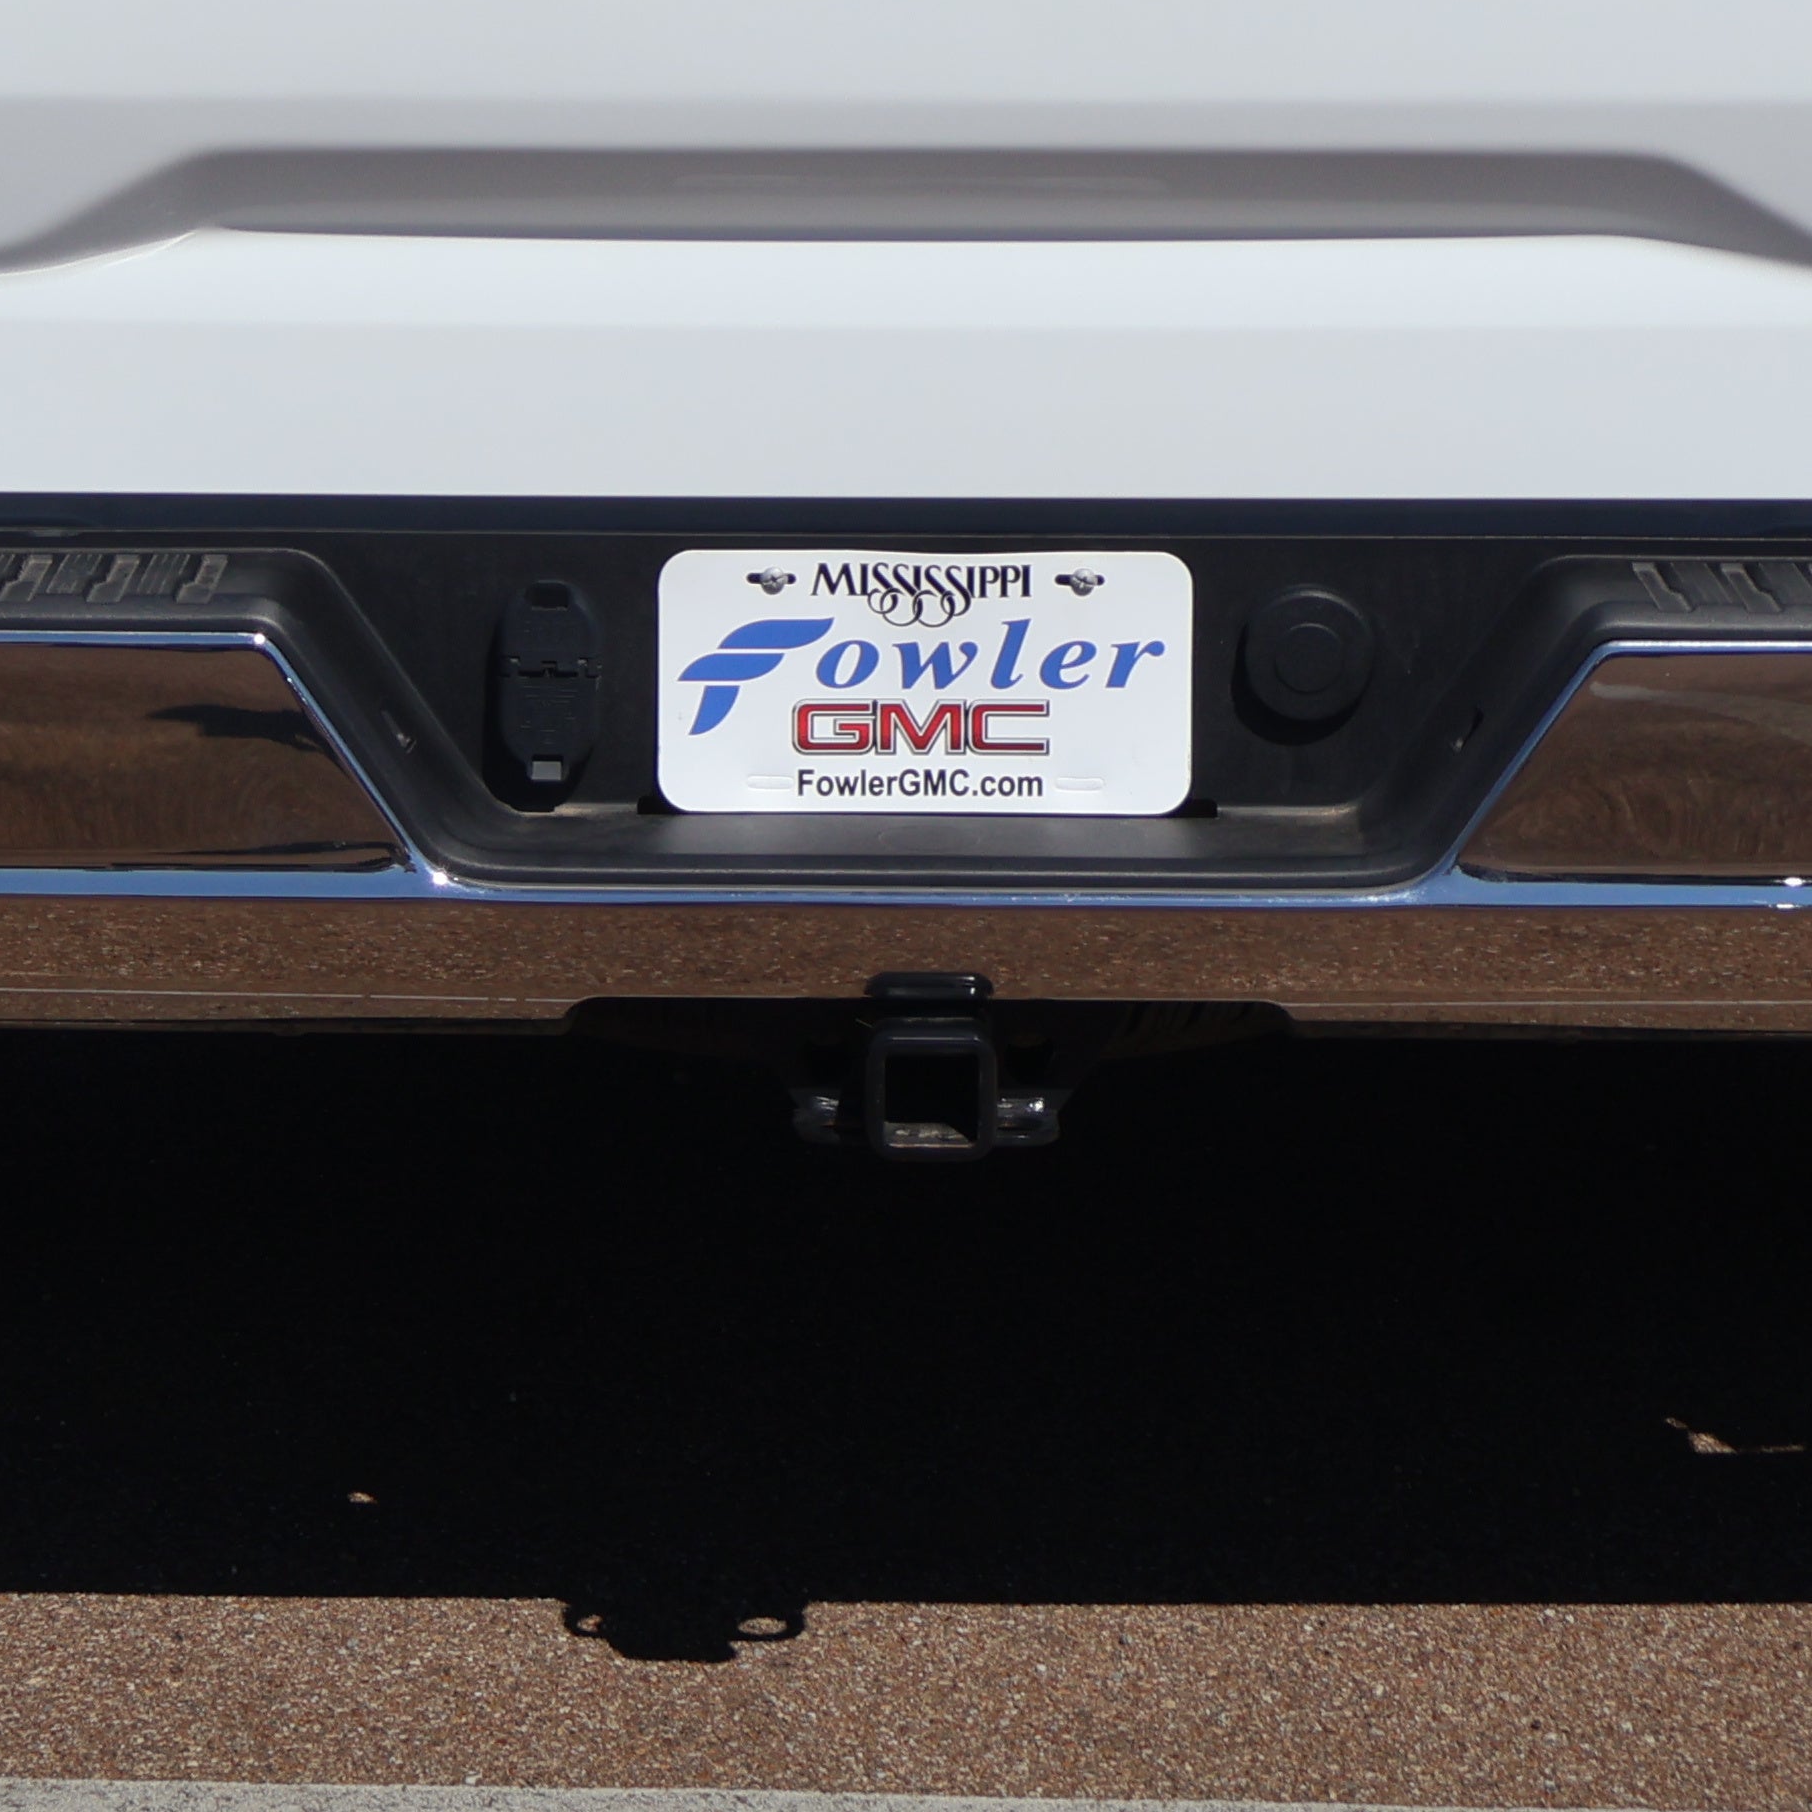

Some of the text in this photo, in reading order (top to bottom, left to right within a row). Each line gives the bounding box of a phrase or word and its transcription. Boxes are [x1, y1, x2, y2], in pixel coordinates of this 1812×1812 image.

[810, 562, 1031, 627] MISSISSIPPI
[677, 617, 1166, 736] Fowler
[791, 699, 1050, 756] GMC
[796, 768, 1044, 797] FowlerGMC.com
